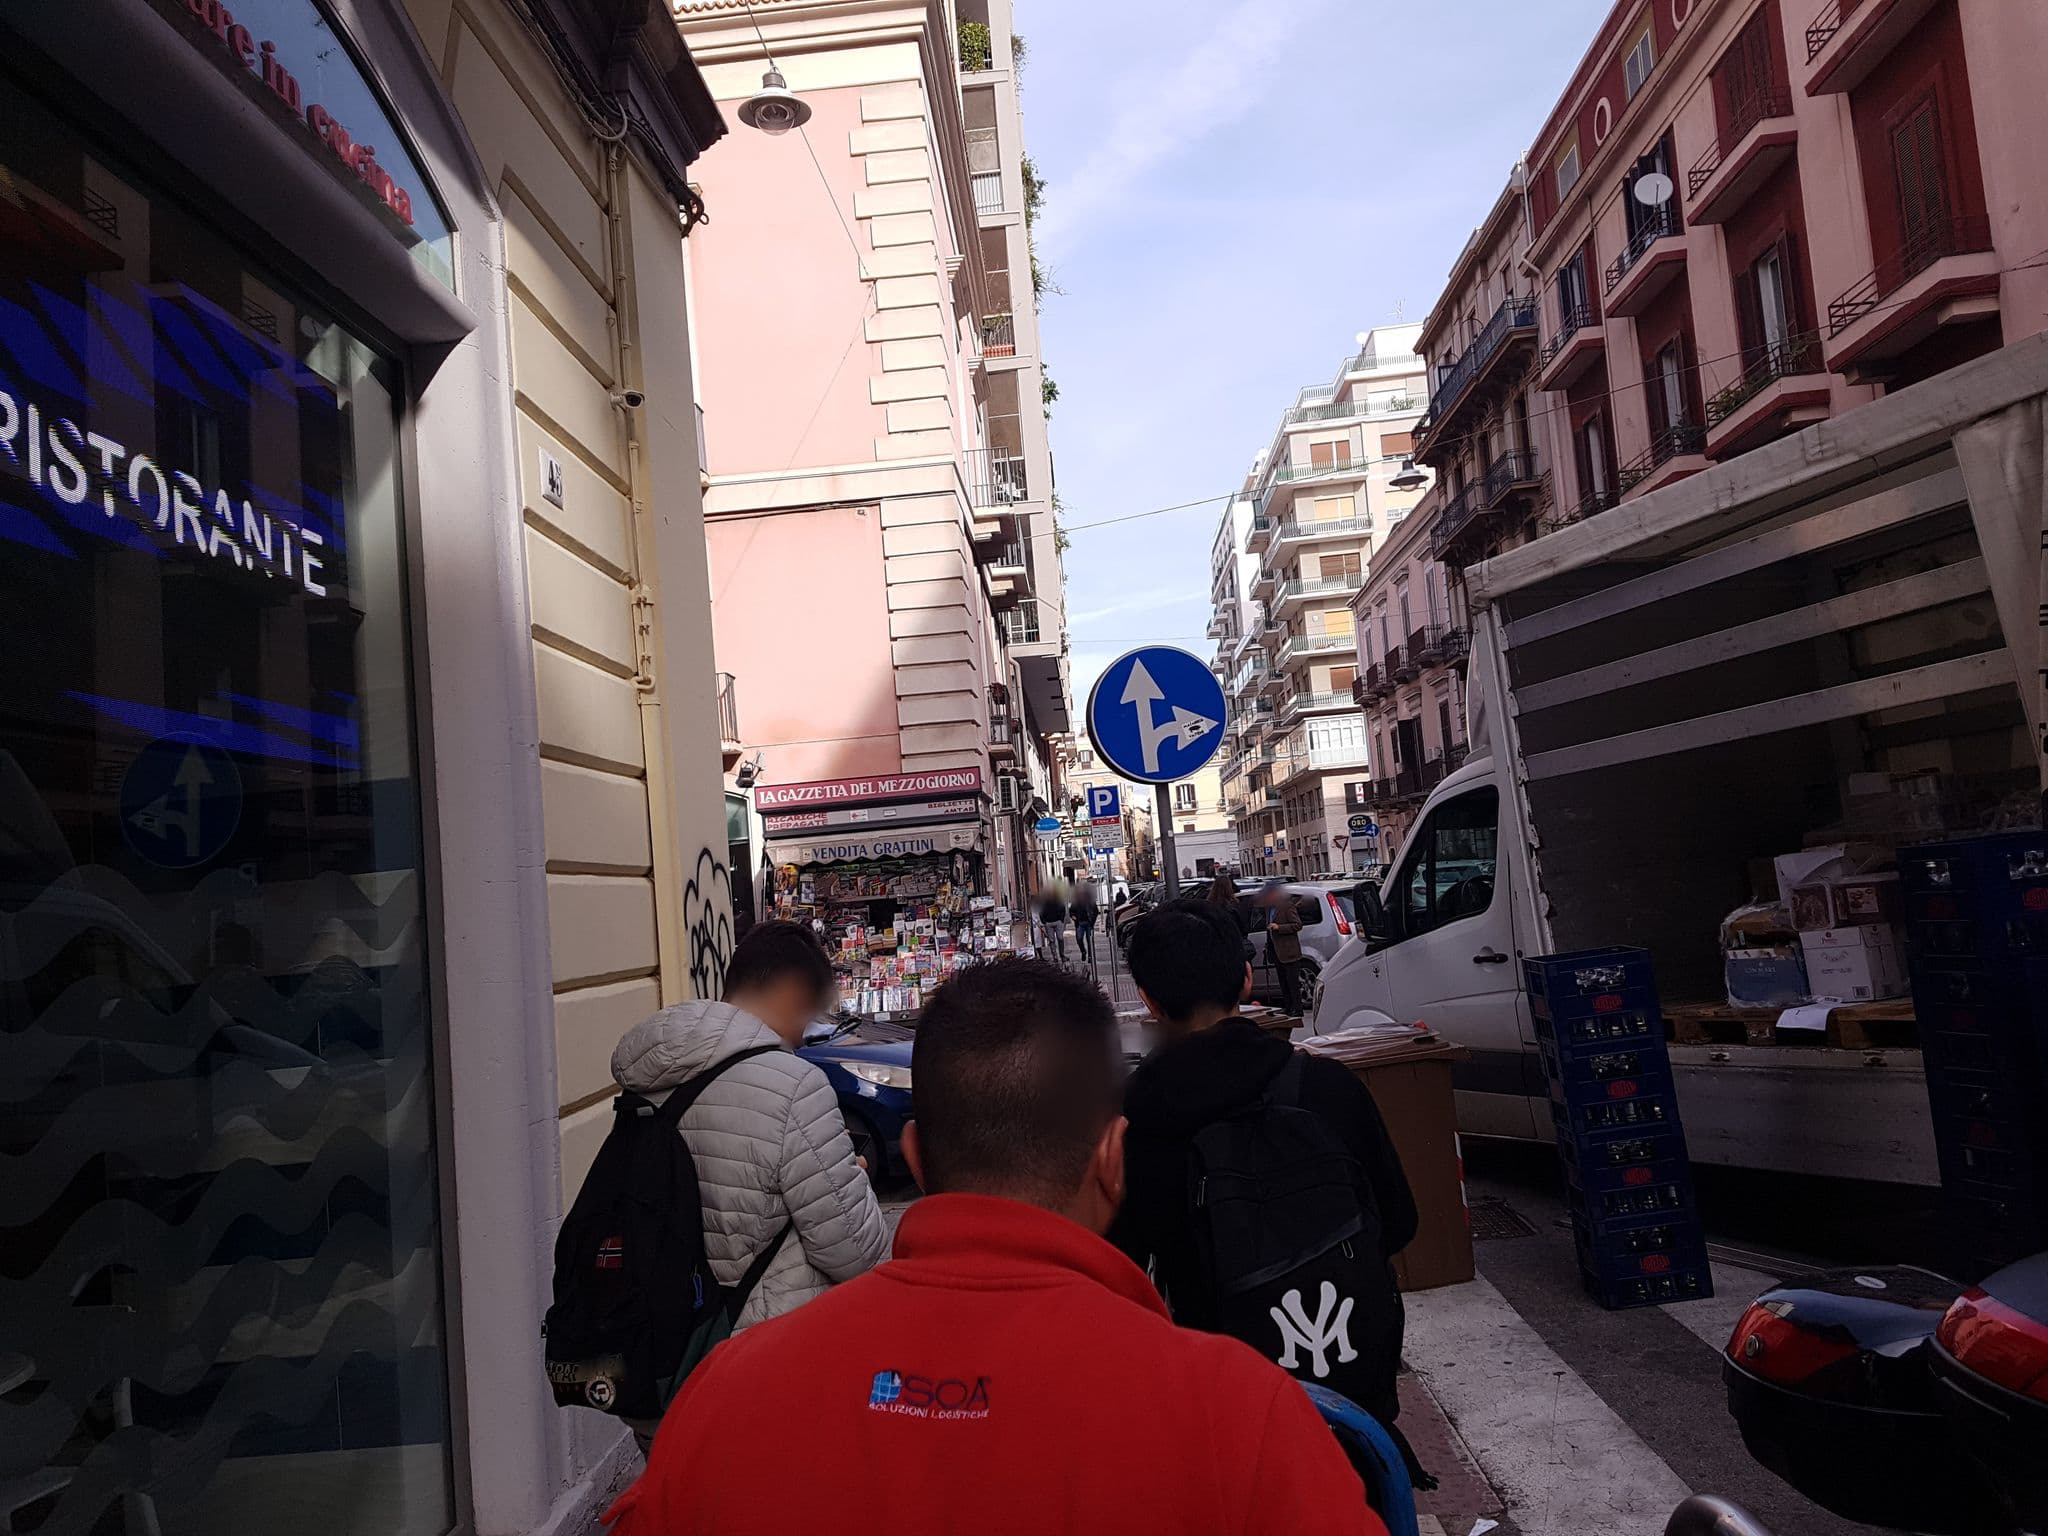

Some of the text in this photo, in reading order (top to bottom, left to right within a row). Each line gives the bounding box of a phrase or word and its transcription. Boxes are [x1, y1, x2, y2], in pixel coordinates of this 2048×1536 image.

[261, 40, 304, 119] in
[306, 104, 414, 225] cucina
[0, 390, 326, 597] RISTORANTE
[760, 772, 975, 804] LA GAZZETTA DEL MEZZOGIORNO
[1094, 789, 1113, 815] P
[927, 799, 974, 809] BIGLIETTI
[813, 845, 868, 860] VENDITA
[873, 838, 934, 856] GRATTINI
[1269, 1279, 1359, 1378] NY
[868, 1403, 989, 1420] SOLUZIONI LOGISTICHE
